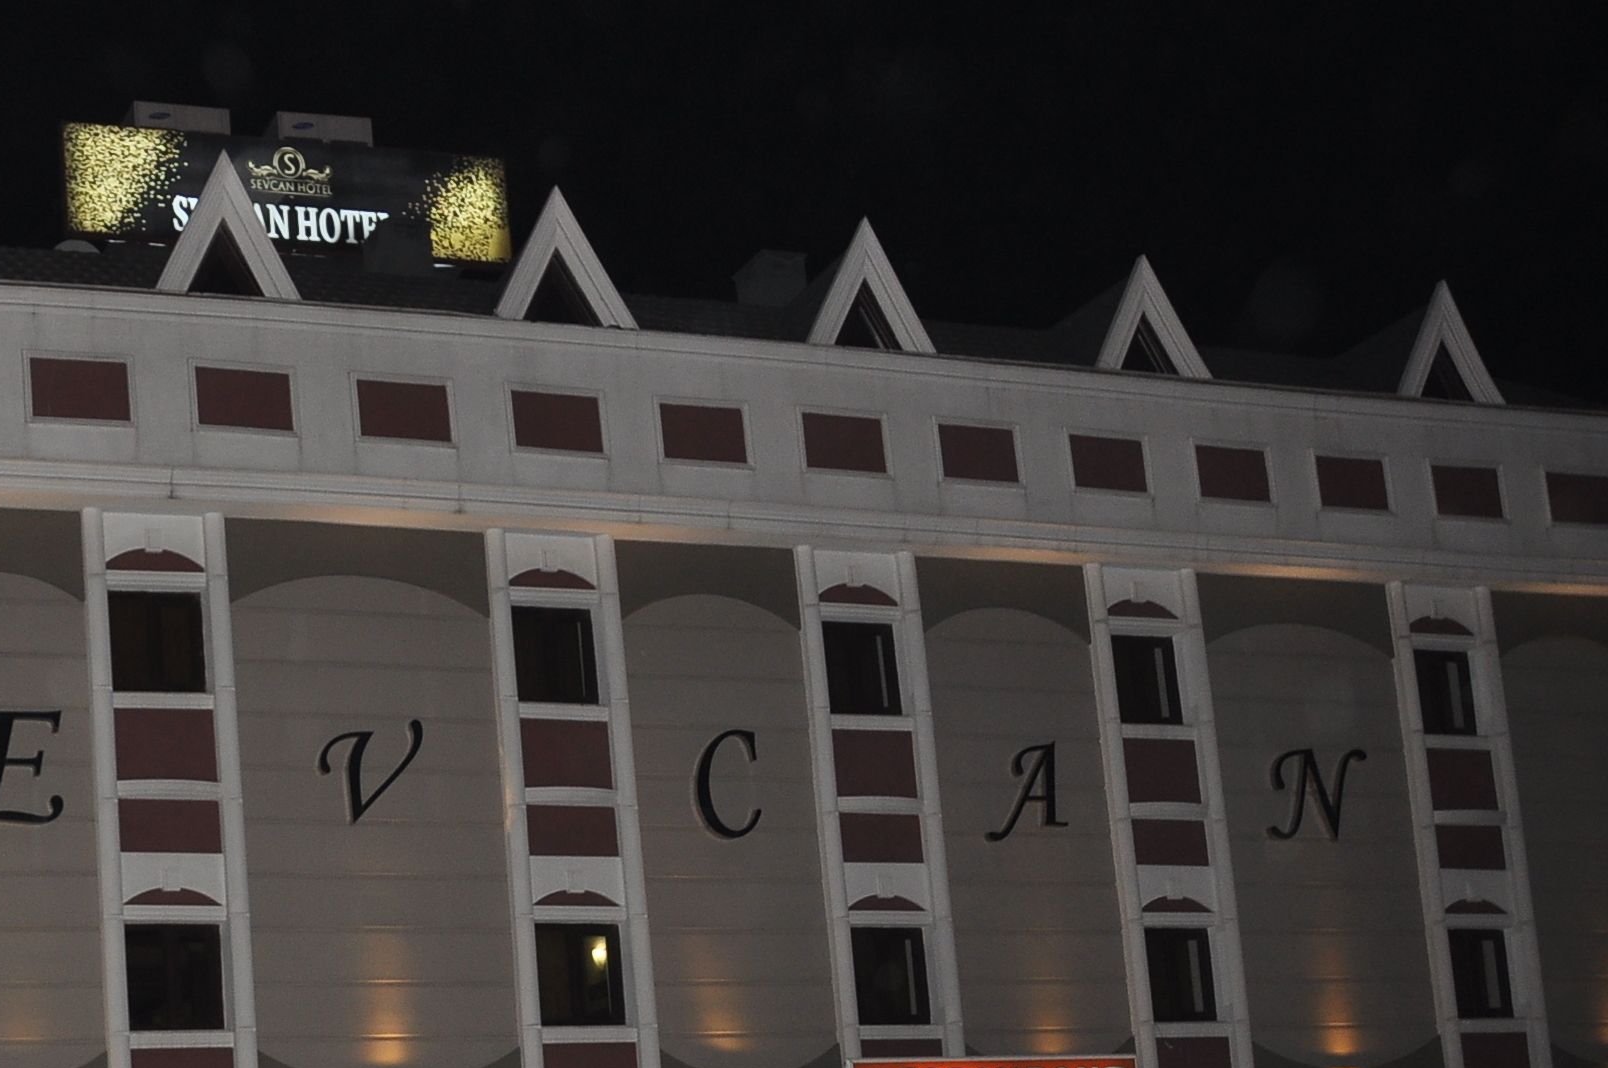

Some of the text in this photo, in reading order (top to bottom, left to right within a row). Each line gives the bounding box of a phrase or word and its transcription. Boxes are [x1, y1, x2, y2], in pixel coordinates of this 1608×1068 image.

[250, 178, 333, 195] SEVCAN HOTEL
[294, 205, 390, 244] HOTE
